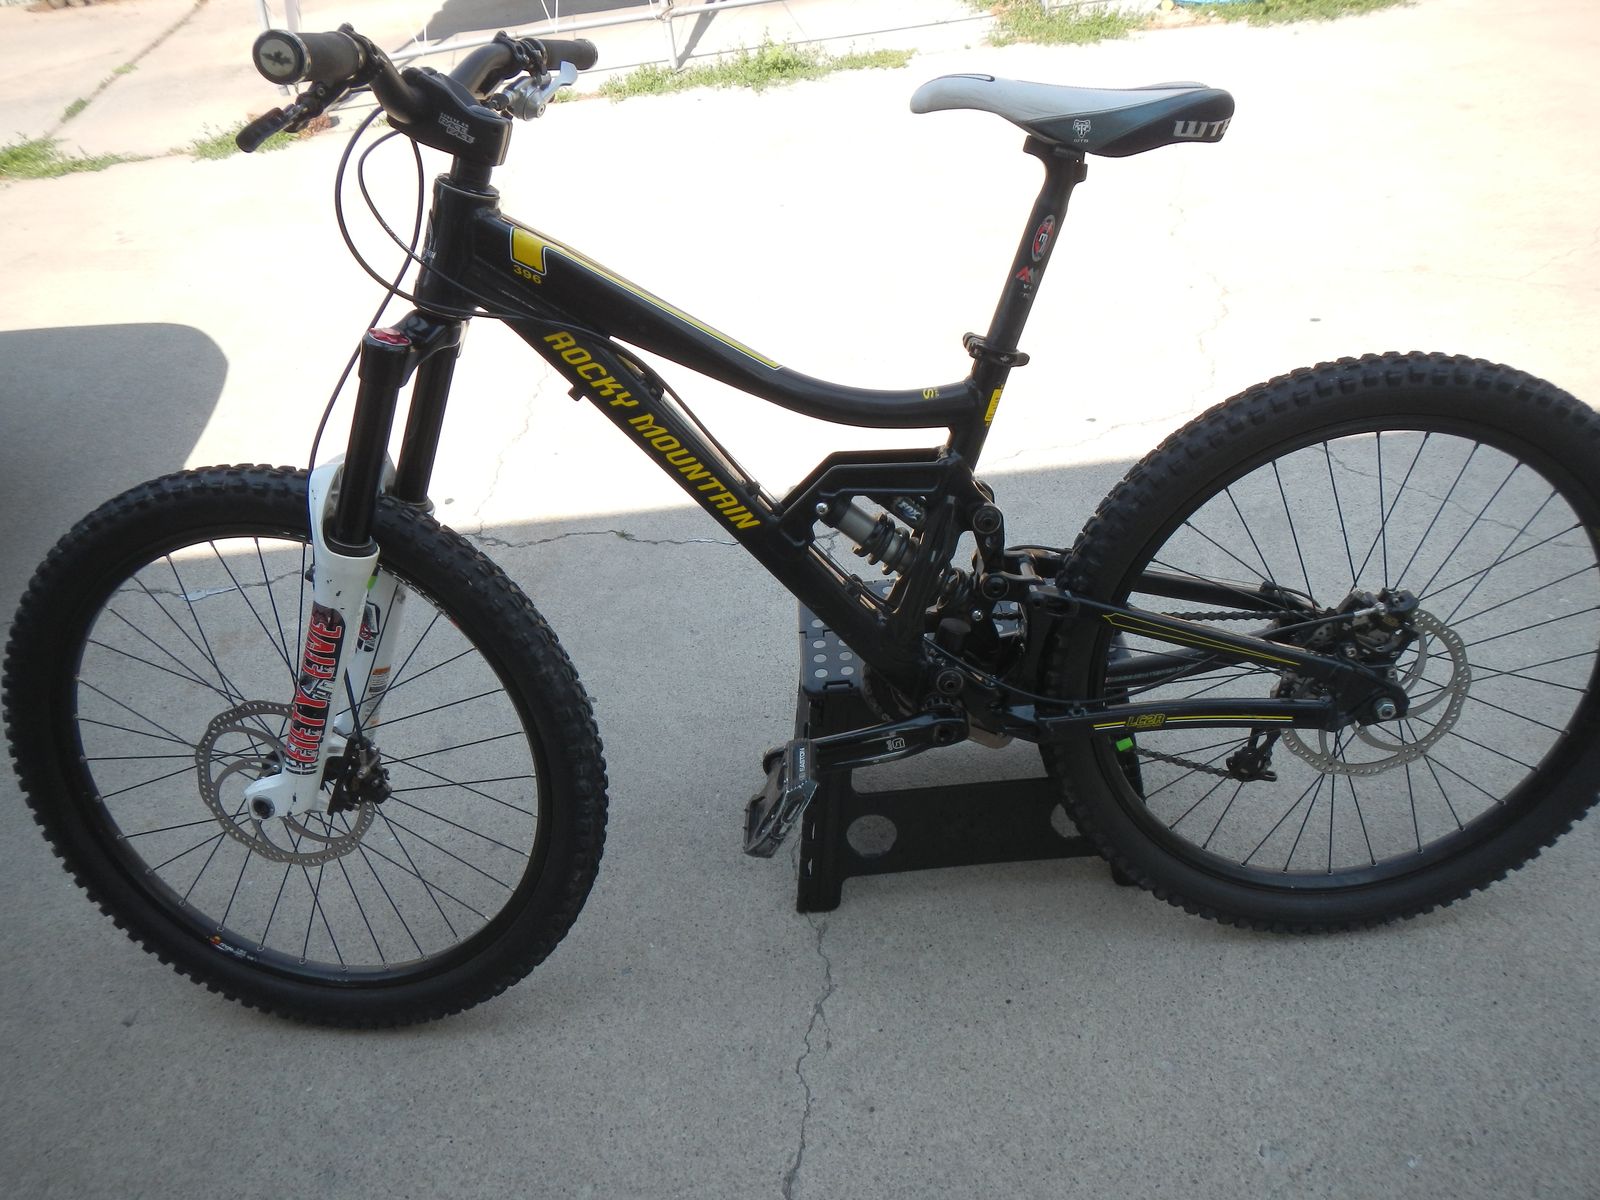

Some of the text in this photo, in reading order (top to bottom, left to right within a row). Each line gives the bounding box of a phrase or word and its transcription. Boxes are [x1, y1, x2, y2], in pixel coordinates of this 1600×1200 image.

[512, 264, 542, 285] 396
[543, 330, 761, 529] ROCKY MOUNTAIN
[303, 615, 343, 679] FIVE
[285, 685, 328, 763] FIFTY
